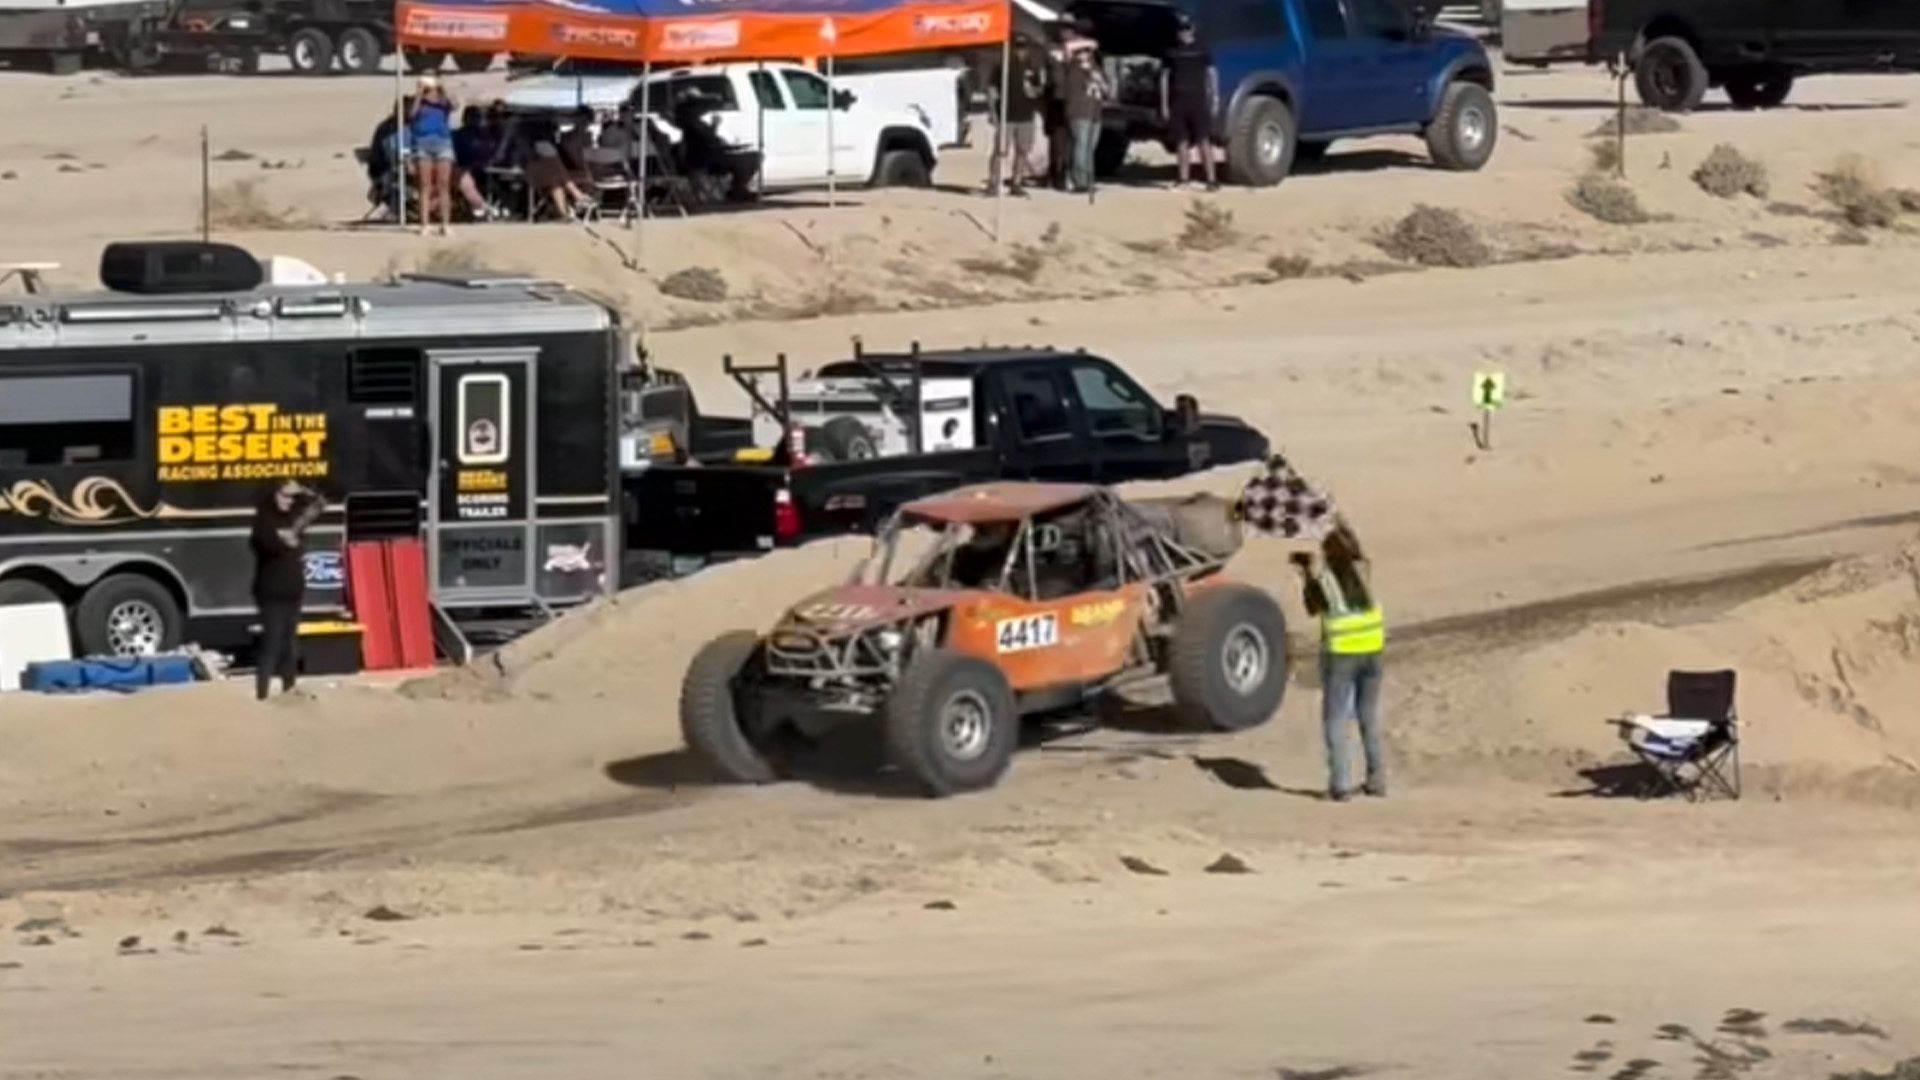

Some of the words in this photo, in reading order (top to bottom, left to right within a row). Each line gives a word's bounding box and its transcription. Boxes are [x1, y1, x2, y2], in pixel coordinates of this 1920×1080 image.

[158, 403, 276, 433] BEST
[273, 415, 291, 430] IN
[295, 413, 325, 429] THE
[159, 431, 326, 463] DESERT
[158, 463, 217, 480] RACING
[222, 461, 327, 478] ASSOCIATION
[456, 493, 509, 504] SCORING
[458, 506, 508, 517] TRAILER
[445, 537, 522, 551] OFFICIALS
[460, 556, 502, 570] ONLY
[999, 614, 1055, 648] 4417
